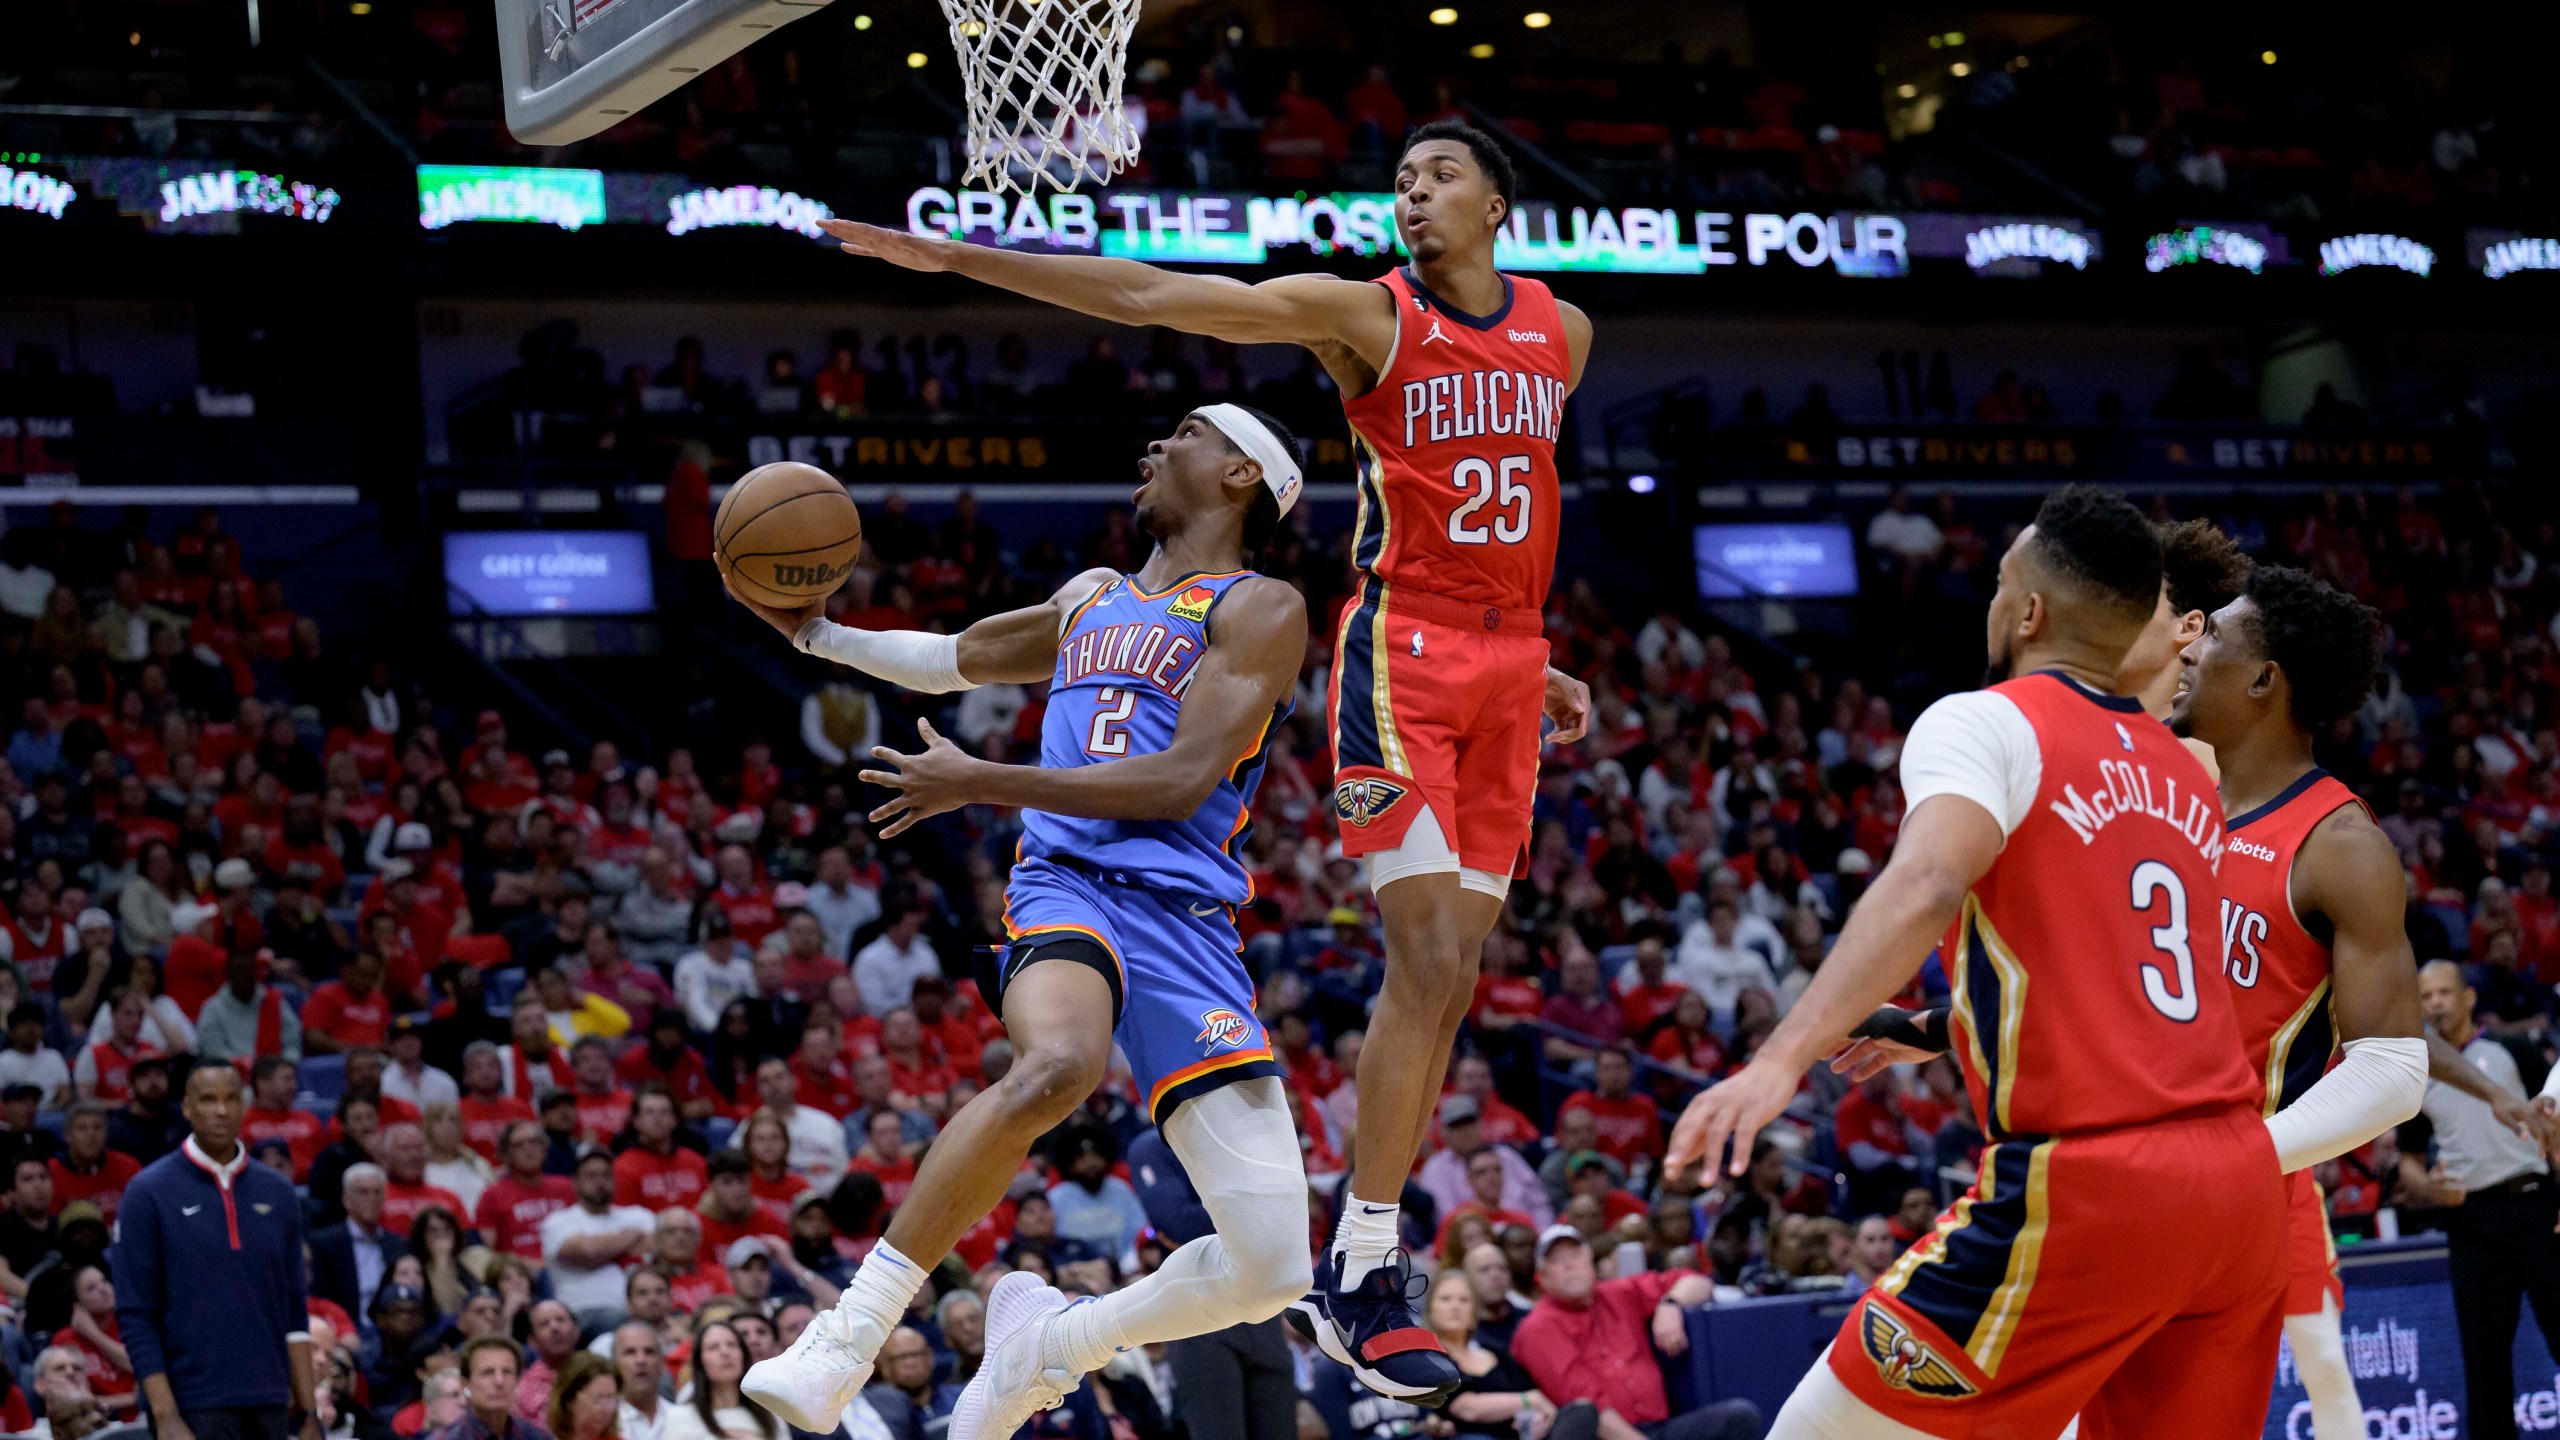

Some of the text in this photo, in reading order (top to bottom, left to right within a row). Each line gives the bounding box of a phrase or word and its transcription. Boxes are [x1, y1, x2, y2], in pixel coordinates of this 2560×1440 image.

[667, 186, 835, 238] JAMESON
[907, 187, 1098, 247] GRAB
[1109, 194, 1231, 252] THE
[1745, 212, 1908, 272] POUR
[1966, 223, 2093, 270] JAMESON
[2318, 234, 2437, 277] JAMESON
[1507, 328, 1547, 344] ibotta
[1403, 370, 1567, 448] PELICANS
[747, 434, 1049, 469] BETRIVERS
[1448, 455, 1532, 545] 25
[773, 554, 857, 587] Wilson
[1084, 686, 1140, 757] 2
[2050, 758, 2226, 878] McCOLLUM
[2228, 837, 2276, 862] ibotta
[2130, 858, 2200, 1024] 3
[2286, 1388, 2459, 1440] Gogle
